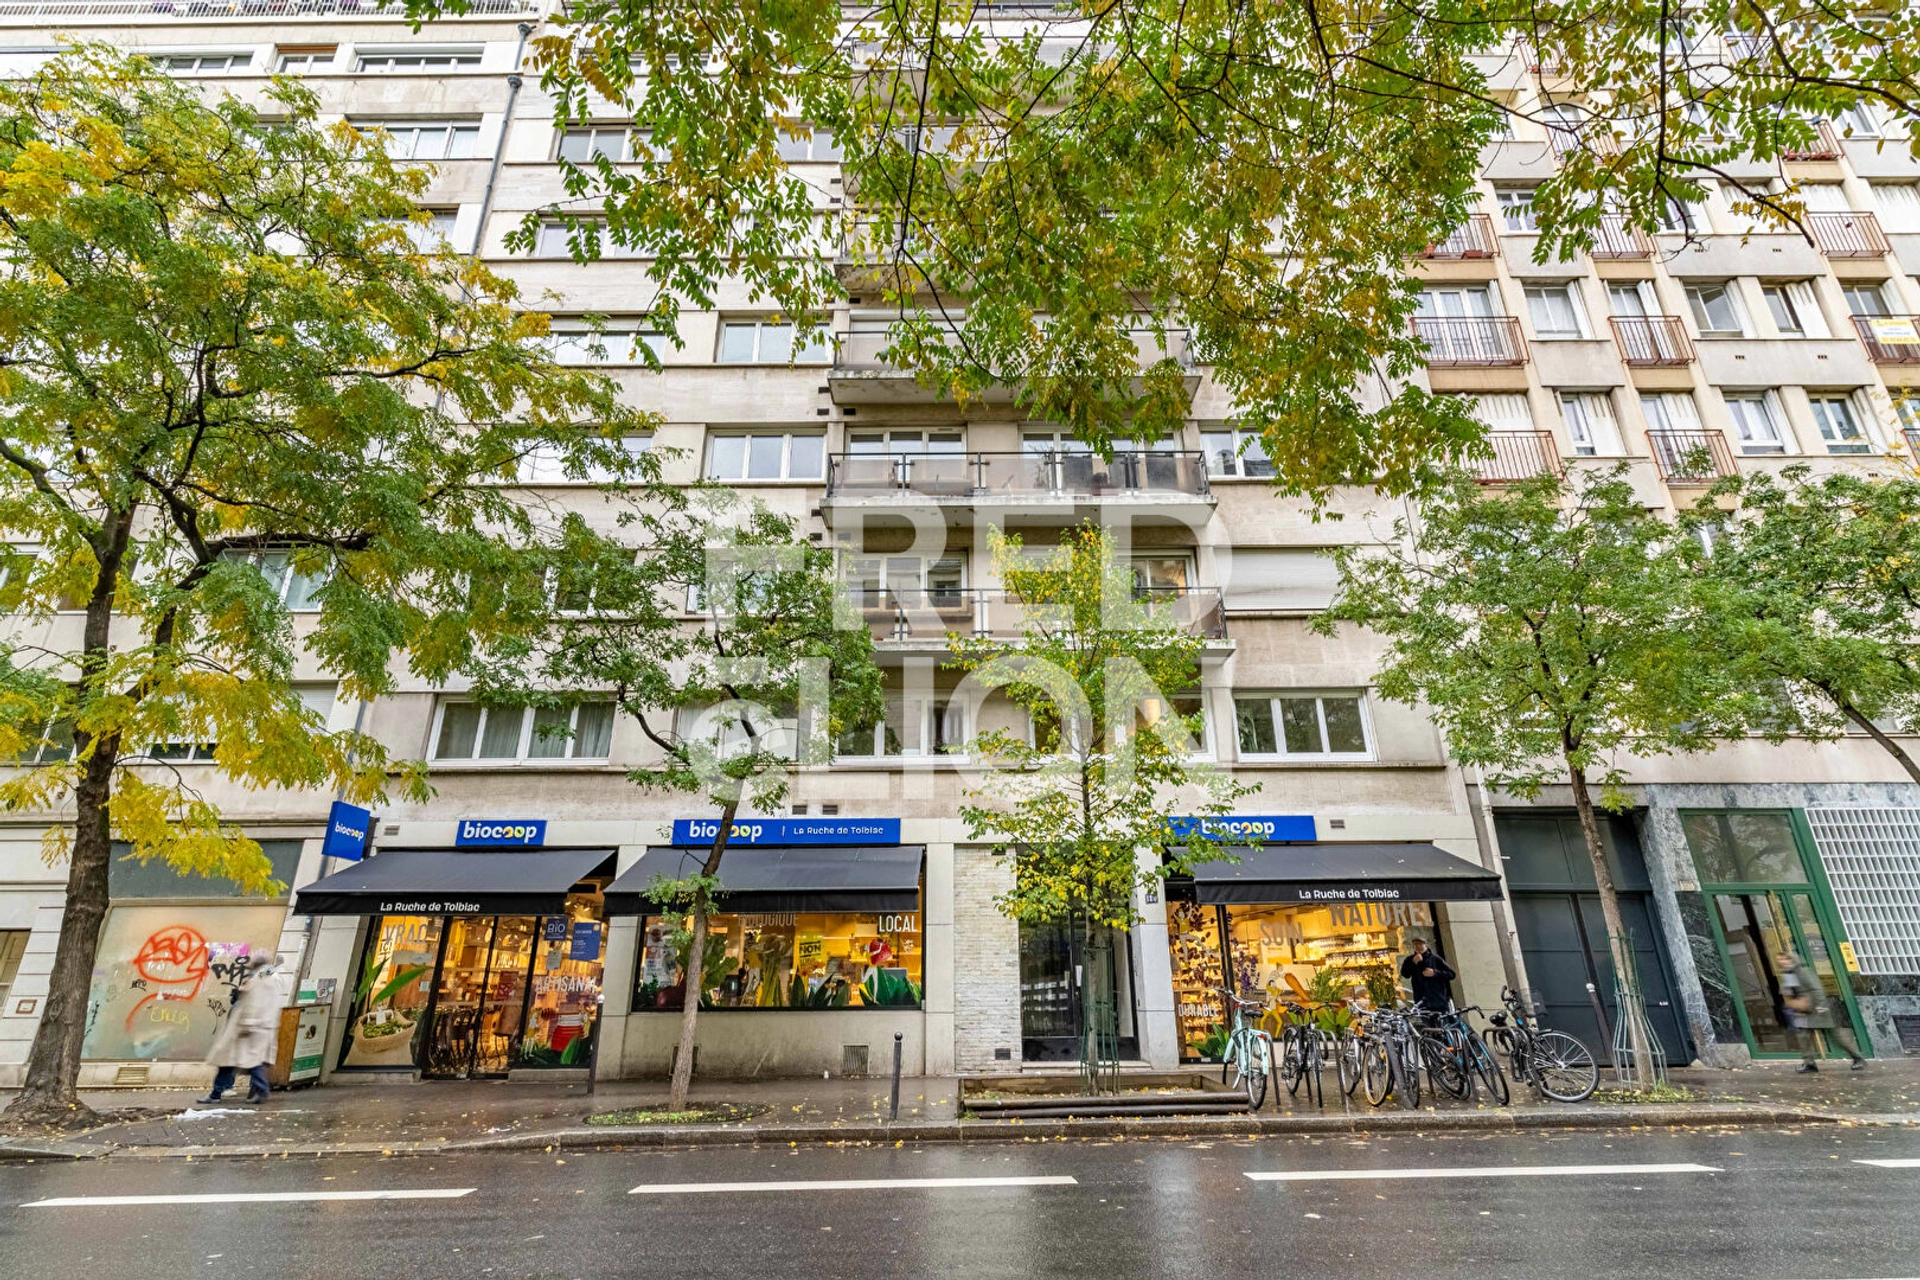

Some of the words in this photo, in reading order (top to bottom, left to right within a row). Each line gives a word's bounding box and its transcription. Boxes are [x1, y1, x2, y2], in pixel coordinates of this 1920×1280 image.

[335, 820, 365, 842] biocoop
[462, 821, 537, 843] biocoop
[689, 820, 763, 842] biooop
[793, 827, 804, 835] La
[806, 826, 835, 835] Ruche
[837, 826, 848, 835] de
[851, 826, 884, 835] Tolbiac
[1299, 889, 1312, 899] La
[1314, 888, 1346, 899] Ruche
[1348, 888, 1361, 899] de
[1362, 888, 1399, 899] Tolbiac
[380, 902, 393, 912] La
[394, 902, 427, 912] Ruche
[428, 902, 441, 912] de
[444, 902, 480, 912] Tolbiac
[878, 914, 919, 932] LOCAL
[385, 923, 427, 945] VRAC
[1178, 1003, 1219, 1018] DURABLE
